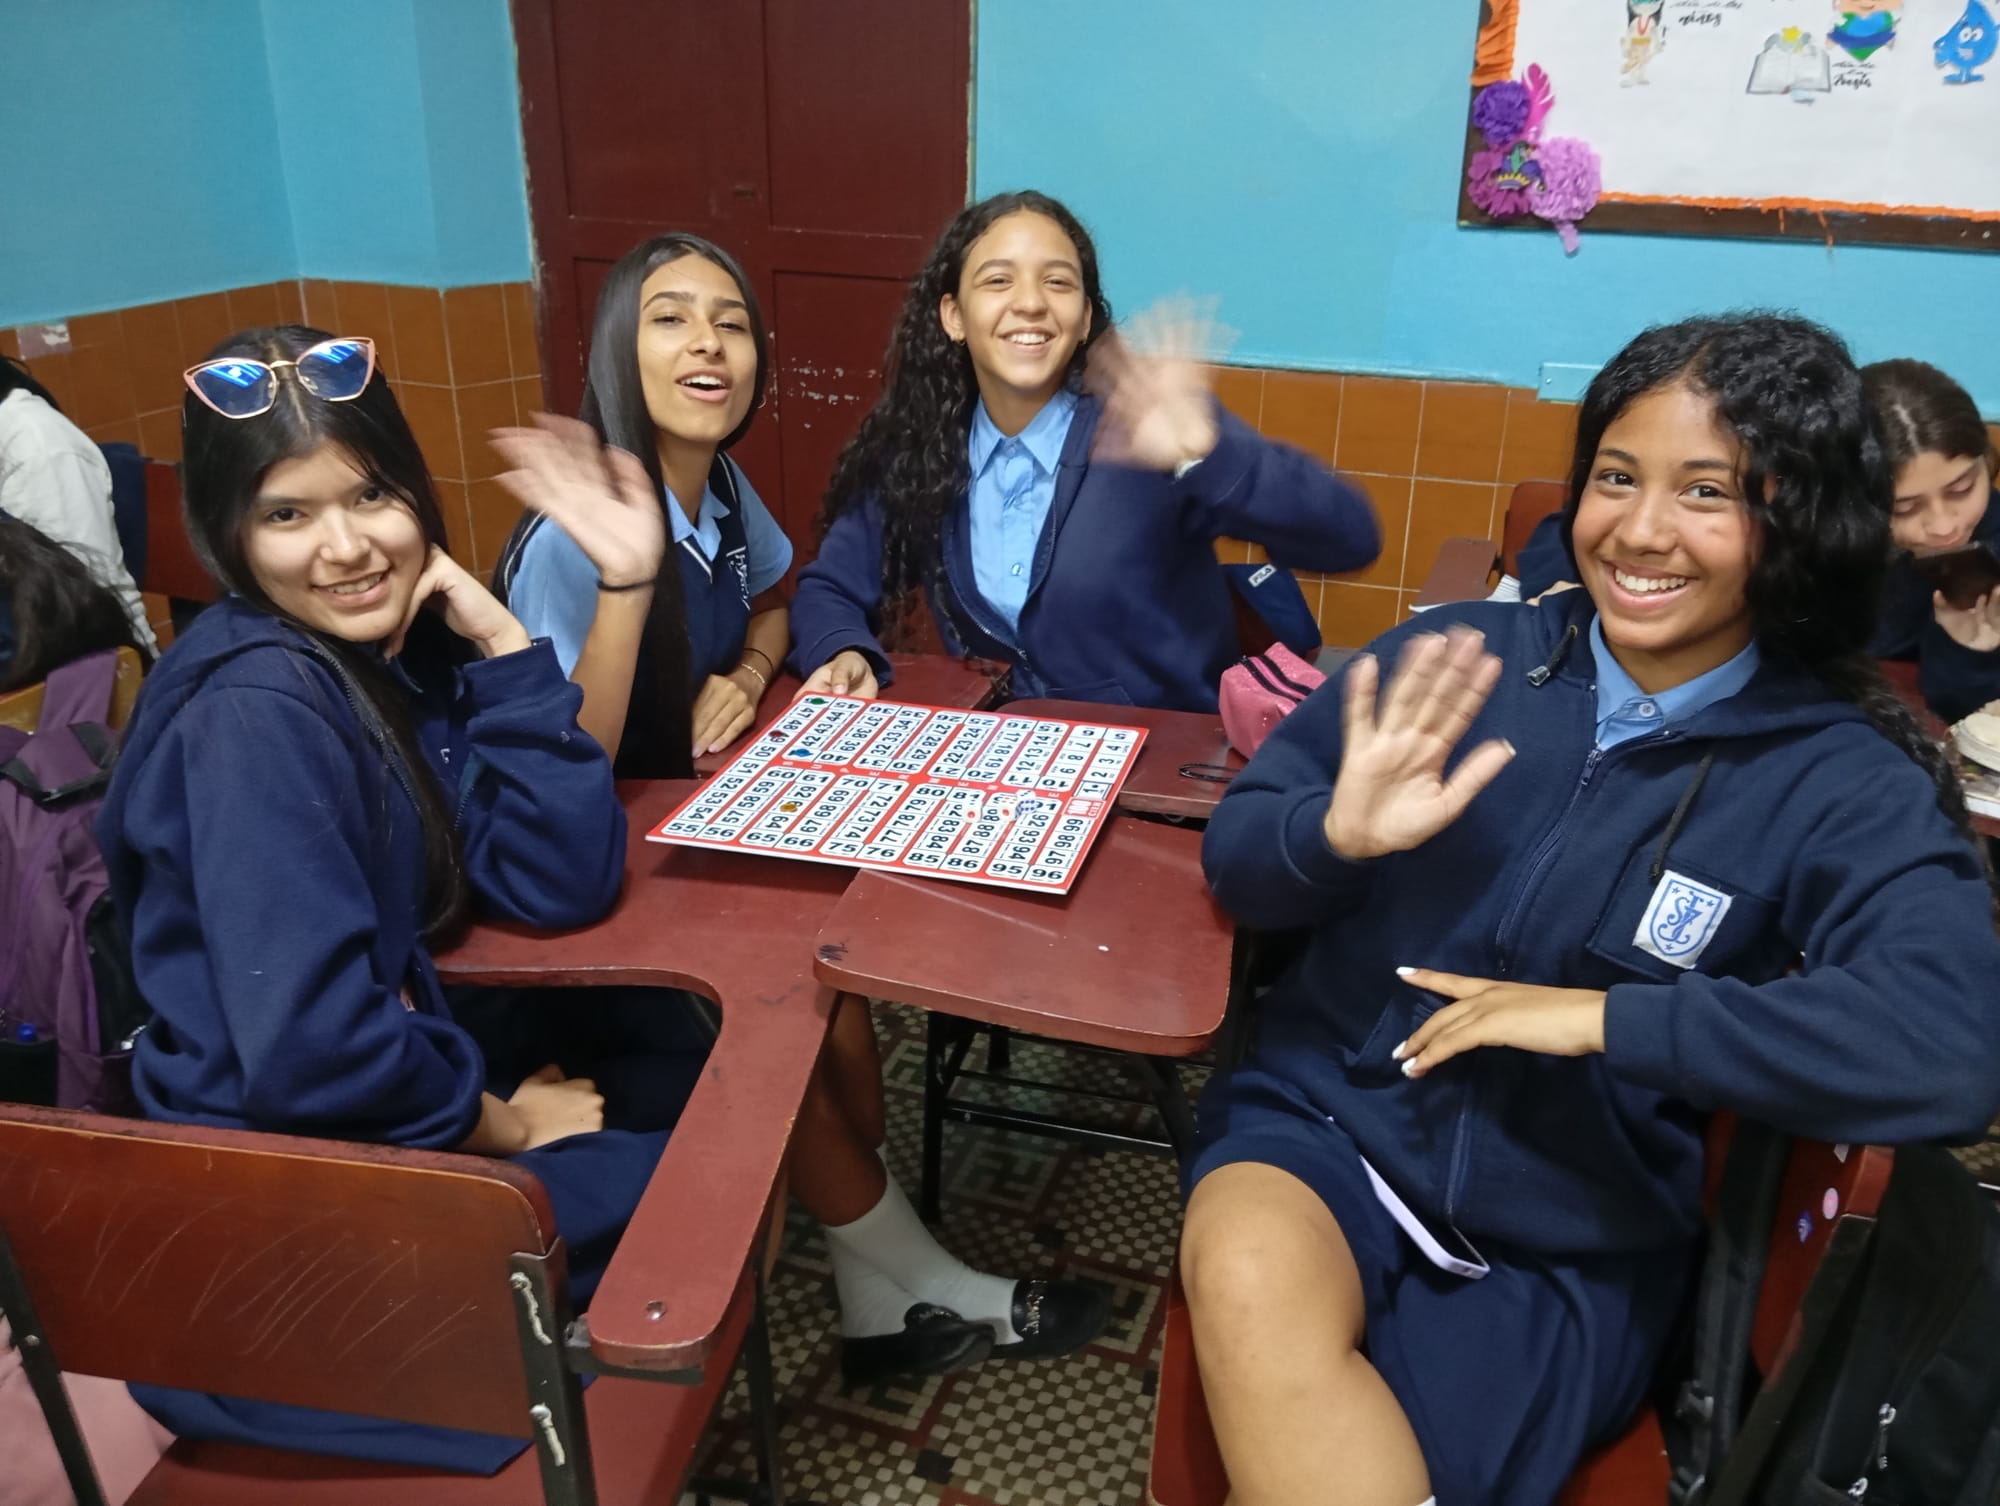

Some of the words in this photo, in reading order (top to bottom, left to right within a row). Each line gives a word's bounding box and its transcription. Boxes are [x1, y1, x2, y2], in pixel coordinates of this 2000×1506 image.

[798, 707, 814, 718] 47
[826, 712, 845, 722] 44
[783, 720, 802, 730] 48
[864, 716, 883, 727] 37
[893, 720, 912, 730] 34
[969, 718, 995, 726] 25
[814, 723, 833, 734] 43
[852, 728, 872, 738] 38
[933, 724, 951, 735] 27
[963, 728, 982, 738] 24
[801, 736, 821, 747] 42
[882, 732, 902, 742] 33
[922, 736, 942, 747] 28
[1004, 733, 1021, 742] 17
[1033, 736, 1051, 745] 14
[840, 741, 860, 751] 39
[870, 744, 892, 755] 32
[953, 740, 973, 751] 23
[755, 746, 776, 757] 50
[911, 749, 931, 759] 29
[1024, 748, 1043, 758] 13
[859, 758, 885, 766] 31
[943, 752, 964, 763] 22
[738, 763, 759, 773] 51
[893, 762, 920, 770] 30
[934, 766, 960, 774] 21
[1016, 761, 1035, 771] 12
[967, 770, 995, 779] 20
[1008, 775, 1032, 783] 11
[720, 778, 744, 789] 52
[752, 781, 775, 793] 59
[842, 778, 868, 787] 70
[878, 783, 902, 791] 71
[1042, 779, 1067, 787] 10
[794, 786, 817, 798] 62
[916, 788, 945, 796] 80
[705, 792, 728, 804] 53
[737, 796, 761, 808] 58
[870, 796, 893, 807] 72
[905, 799, 927, 810] 79
[688, 807, 713, 819] 54
[721, 810, 744, 823] 57
[858, 811, 881, 822] 73
[765, 816, 789, 828] 64
[892, 814, 915, 826] 78
[1028, 814, 1049, 827] 92
[668, 823, 699, 832] 55
[800, 819, 822, 833] 67
[938, 820, 960, 833] 83
[973, 824, 995, 837] 88
[705, 827, 735, 837] 56
[747, 833, 777, 842] 65
[845, 826, 868, 838] 74
[880, 829, 902, 842] 77
[1018, 830, 1040, 843] 93
[829, 842, 857, 852] 75
[926, 835, 949, 849] 84
[962, 840, 983, 854] 87
[867, 847, 895, 857] 76
[1009, 846, 1031, 860] 94
[1045, 850, 1066, 864] 97
[908, 853, 940, 863] 85
[992, 864, 1023, 874] 95
